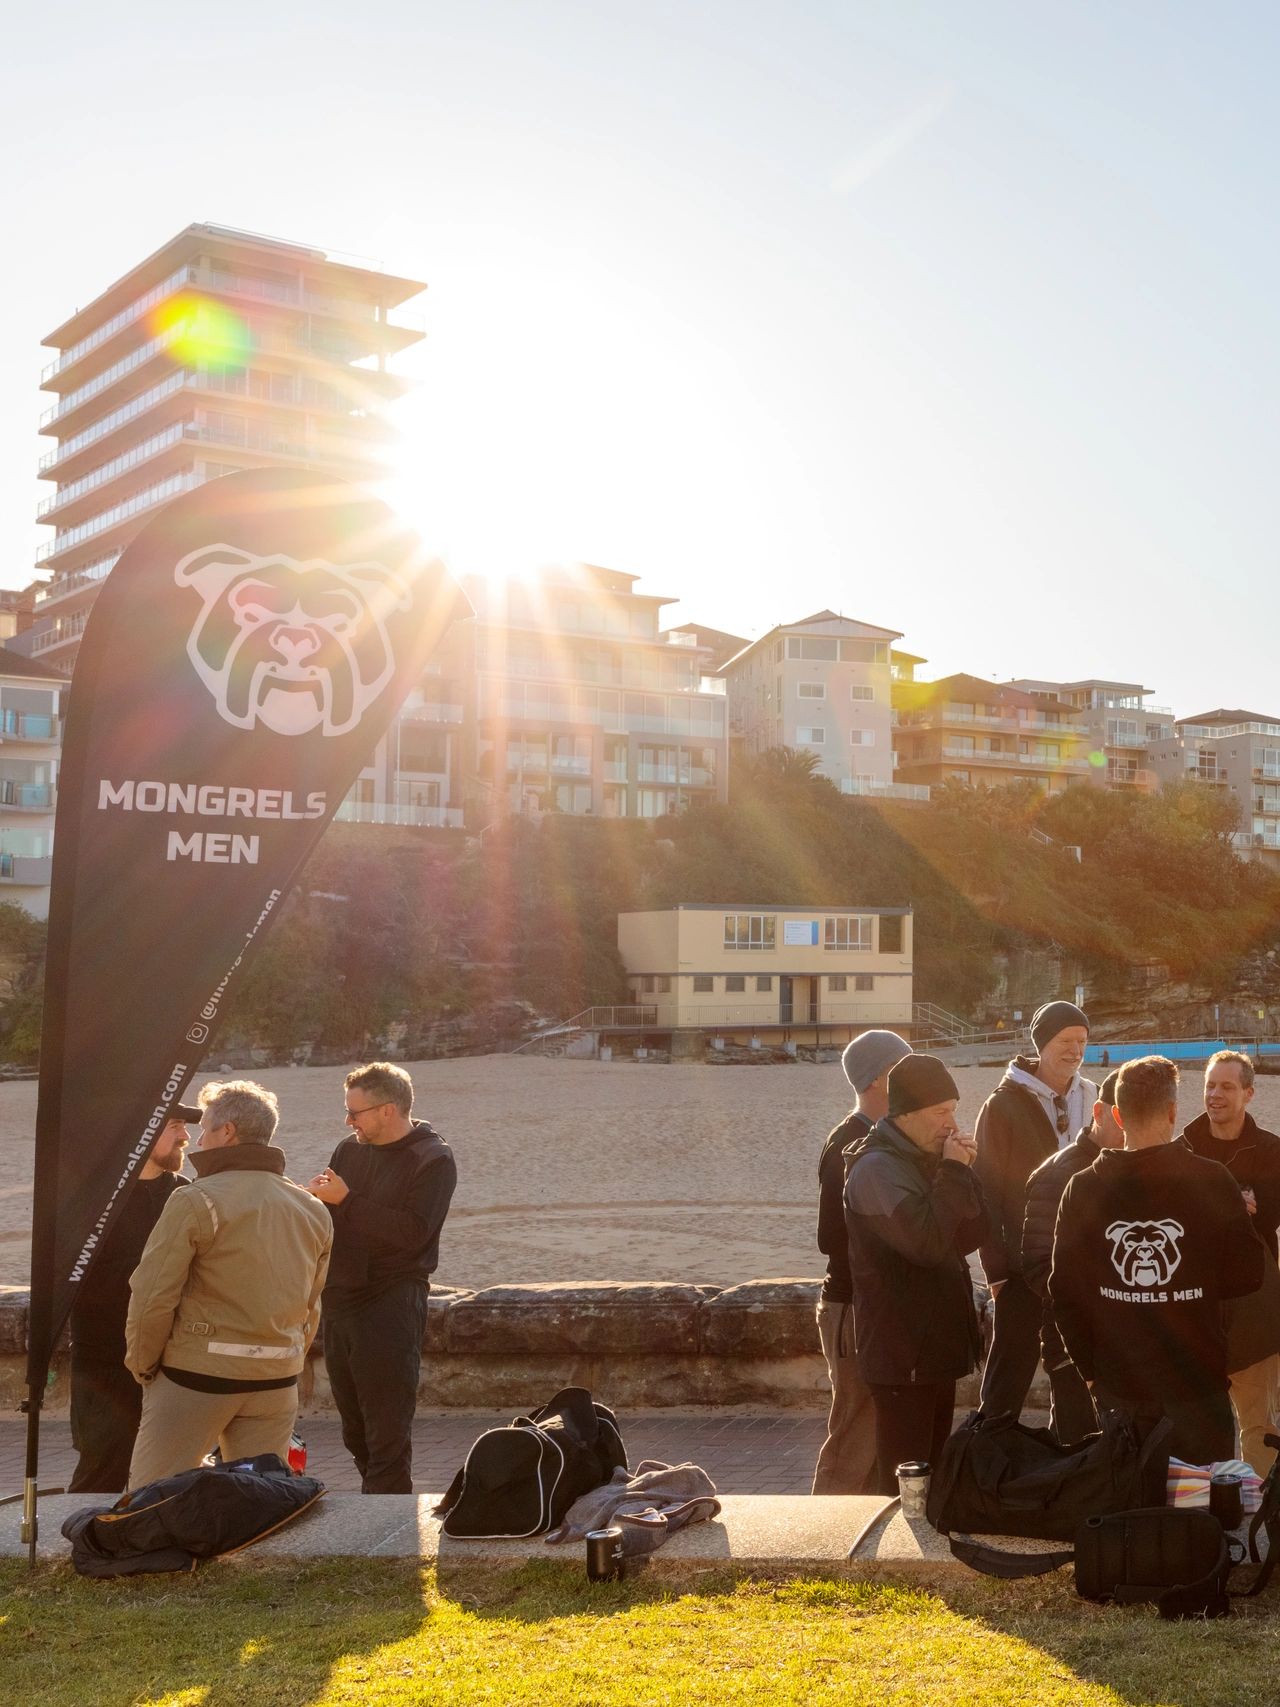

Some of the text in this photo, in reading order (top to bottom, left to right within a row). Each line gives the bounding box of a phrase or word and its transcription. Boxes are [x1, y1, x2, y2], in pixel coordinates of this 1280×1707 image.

[98, 779, 327, 820] MONGRELS
[166, 830, 260, 865] MEN
[1099, 1286, 1203, 1303] MONGRELS MEN
